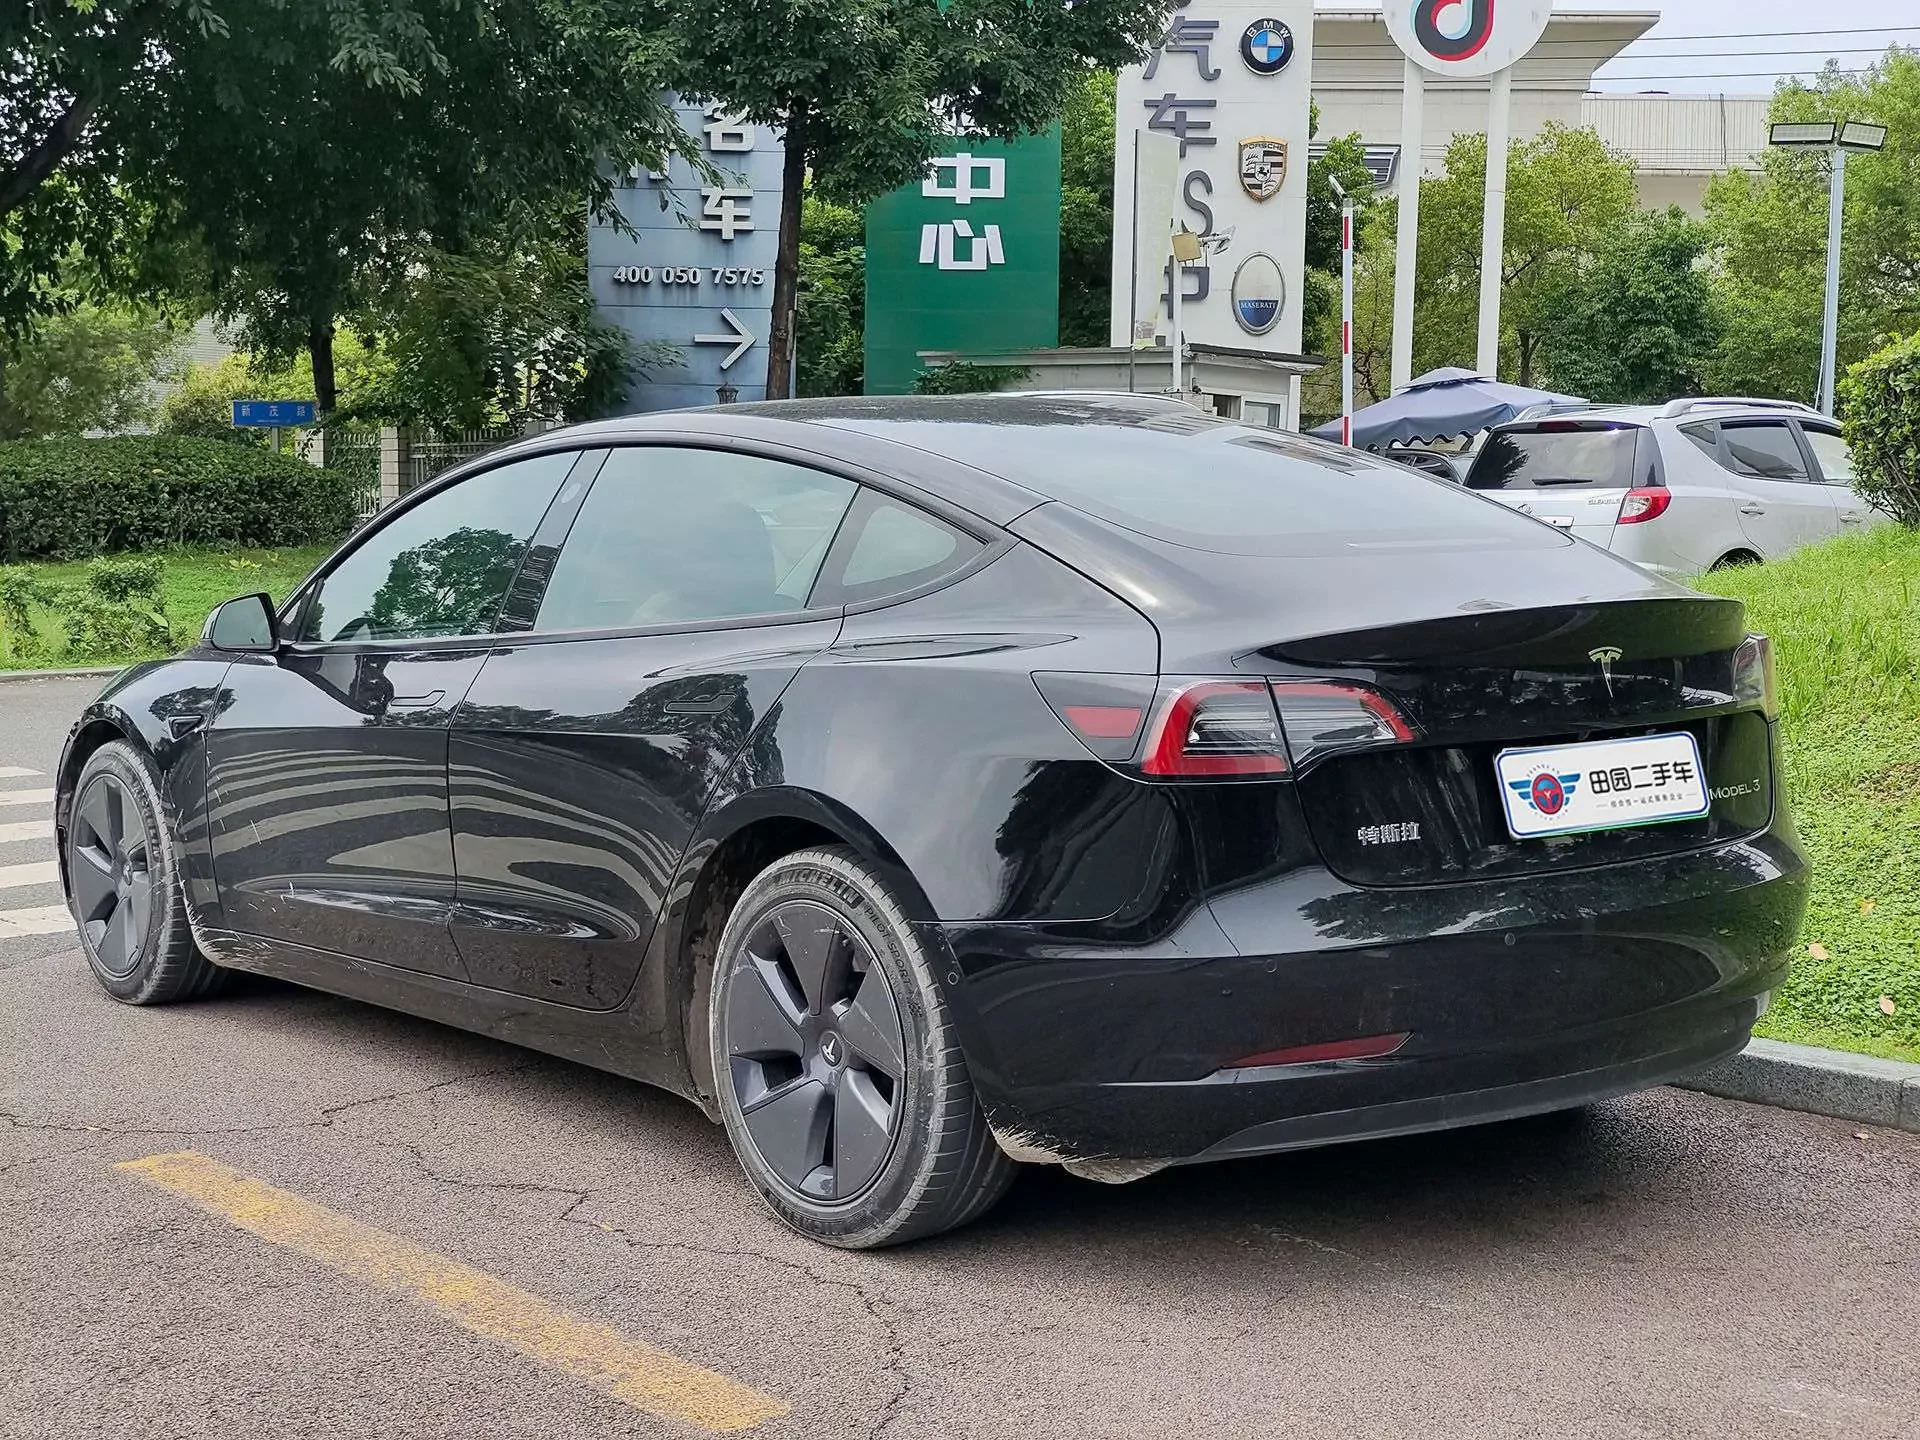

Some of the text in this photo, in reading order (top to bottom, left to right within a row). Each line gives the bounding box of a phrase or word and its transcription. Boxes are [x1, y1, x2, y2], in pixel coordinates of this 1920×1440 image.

[1246, 20, 1291, 39] BMW
[919, 92, 1005, 270] 中心
[613, 266, 764, 285] 400 050 7575
[1589, 761, 1694, 794] 田园二手车
[1709, 779, 1761, 800] MODEL 3
[1358, 822, 1421, 845] 特斯拉
[778, 869, 860, 904] MICHELIN
[864, 905, 912, 986] PILOT SPORT
